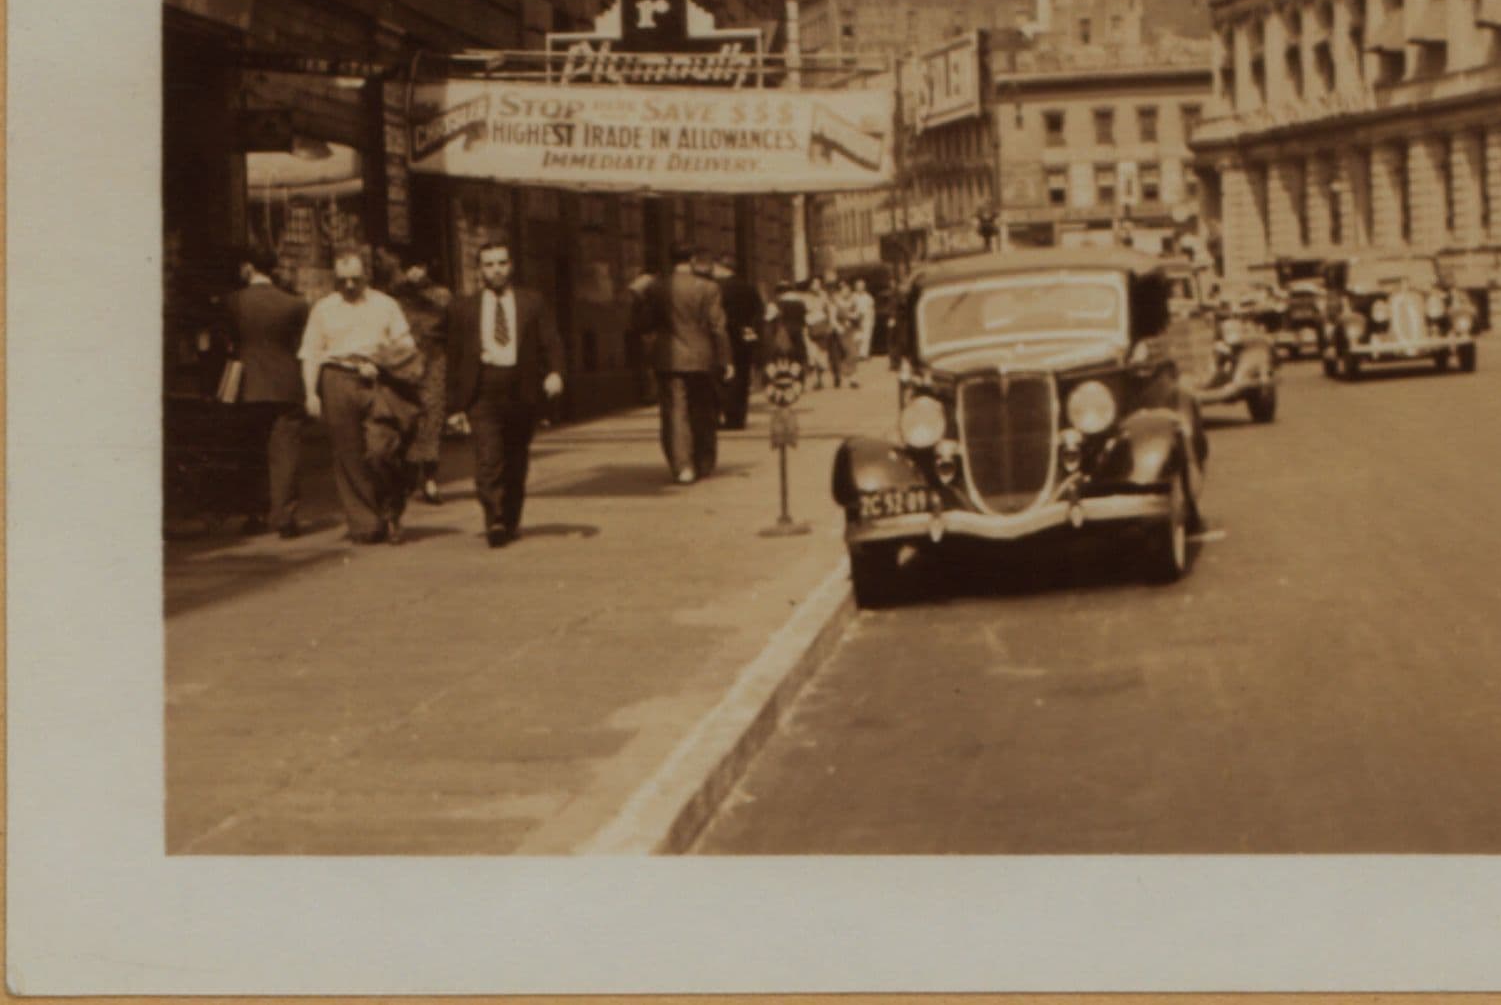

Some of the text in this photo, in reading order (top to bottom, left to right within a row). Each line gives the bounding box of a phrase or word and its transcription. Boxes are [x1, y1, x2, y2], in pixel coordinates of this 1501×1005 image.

[561, 40, 751, 90] Plymouth
[499, 91, 586, 120] STOP
[640, 95, 714, 123] SAVE
[492, 120, 577, 148] HIGHEST
[583, 122, 642, 149] TRADE
[651, 126, 671, 149] IN
[542, 150, 657, 172] IMMEDIATE
